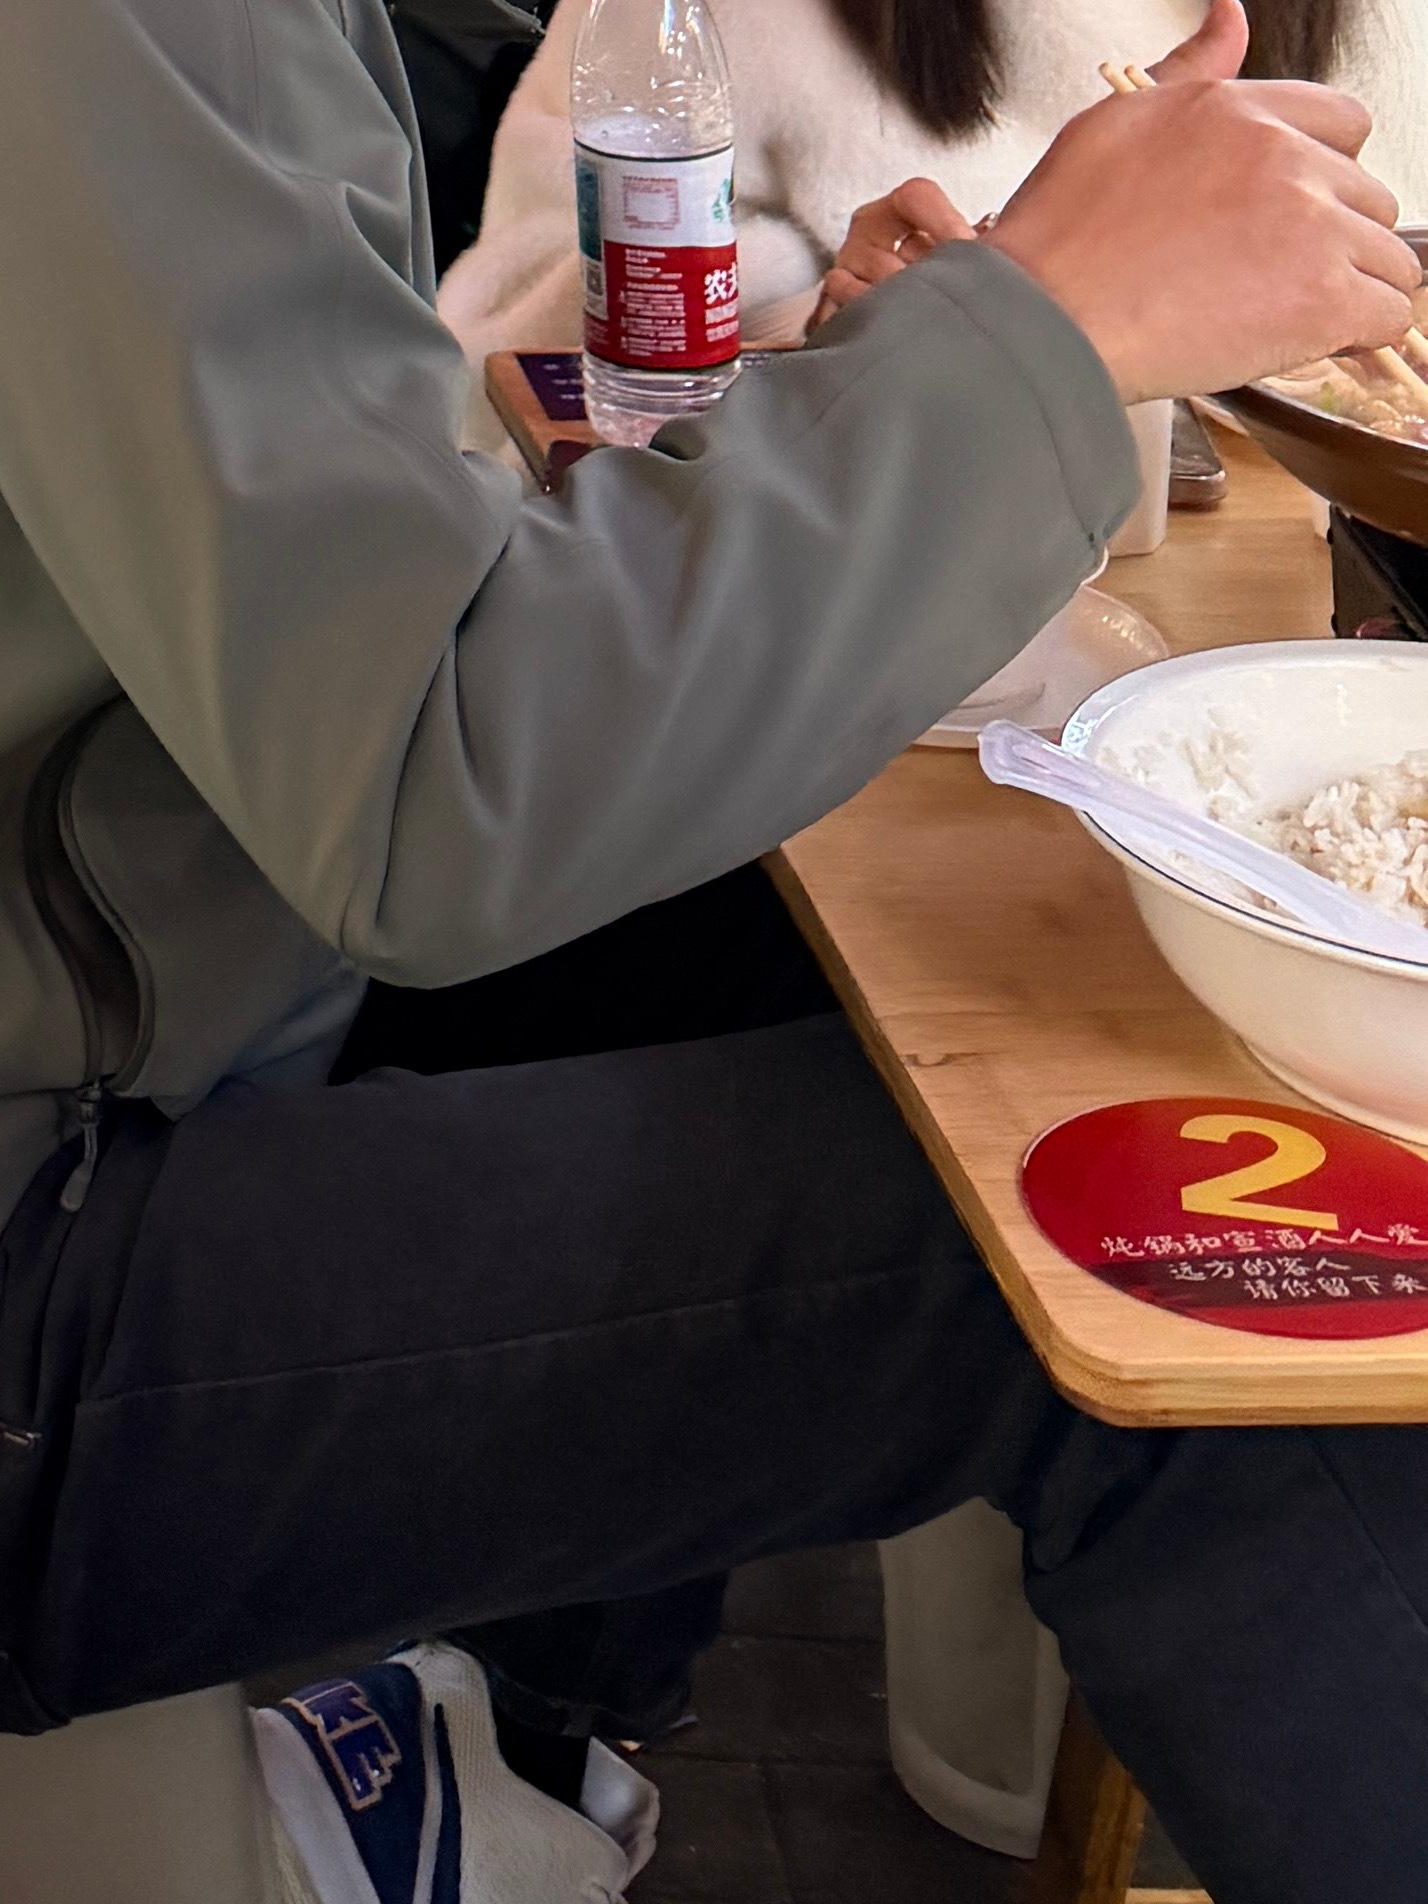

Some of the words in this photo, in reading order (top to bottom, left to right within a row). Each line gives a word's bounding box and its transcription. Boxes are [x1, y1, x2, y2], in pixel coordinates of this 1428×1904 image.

[1179, 1114, 1339, 1231] 2
[1168, 1256, 1351, 1281] 远方的客人
[1244, 1273, 1428, 1300] 请你留下来
